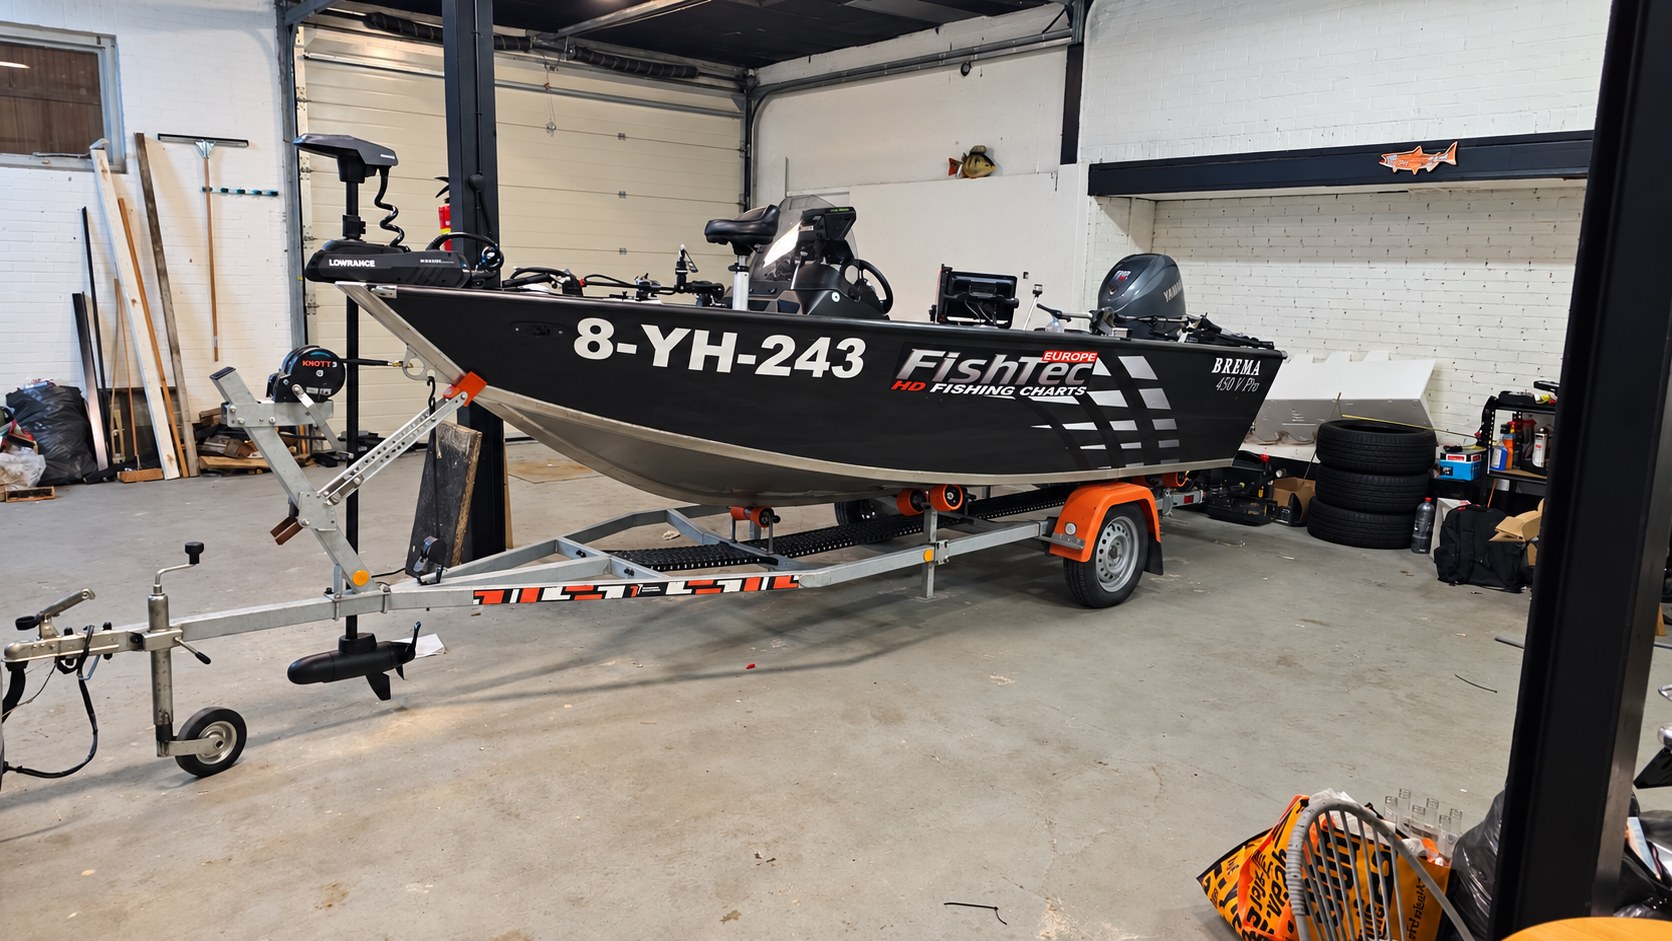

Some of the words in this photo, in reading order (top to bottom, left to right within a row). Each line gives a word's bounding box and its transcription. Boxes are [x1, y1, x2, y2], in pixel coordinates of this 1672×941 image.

[329, 259, 375, 267] LOWRANCE
[573, 317, 866, 379] 8-YH-243
[1043, 351, 1097, 362] EUROPE
[896, 348, 1093, 386] FishTec
[1211, 357, 1261, 376] BREMA
[891, 381, 926, 392] HD
[929, 382, 1014, 396] FISHING
[1019, 386, 1087, 397] CHARTS
[1216, 376, 1236, 391] 450
[1234, 377, 1245, 391] V
[1242, 377, 1260, 392] Pro
